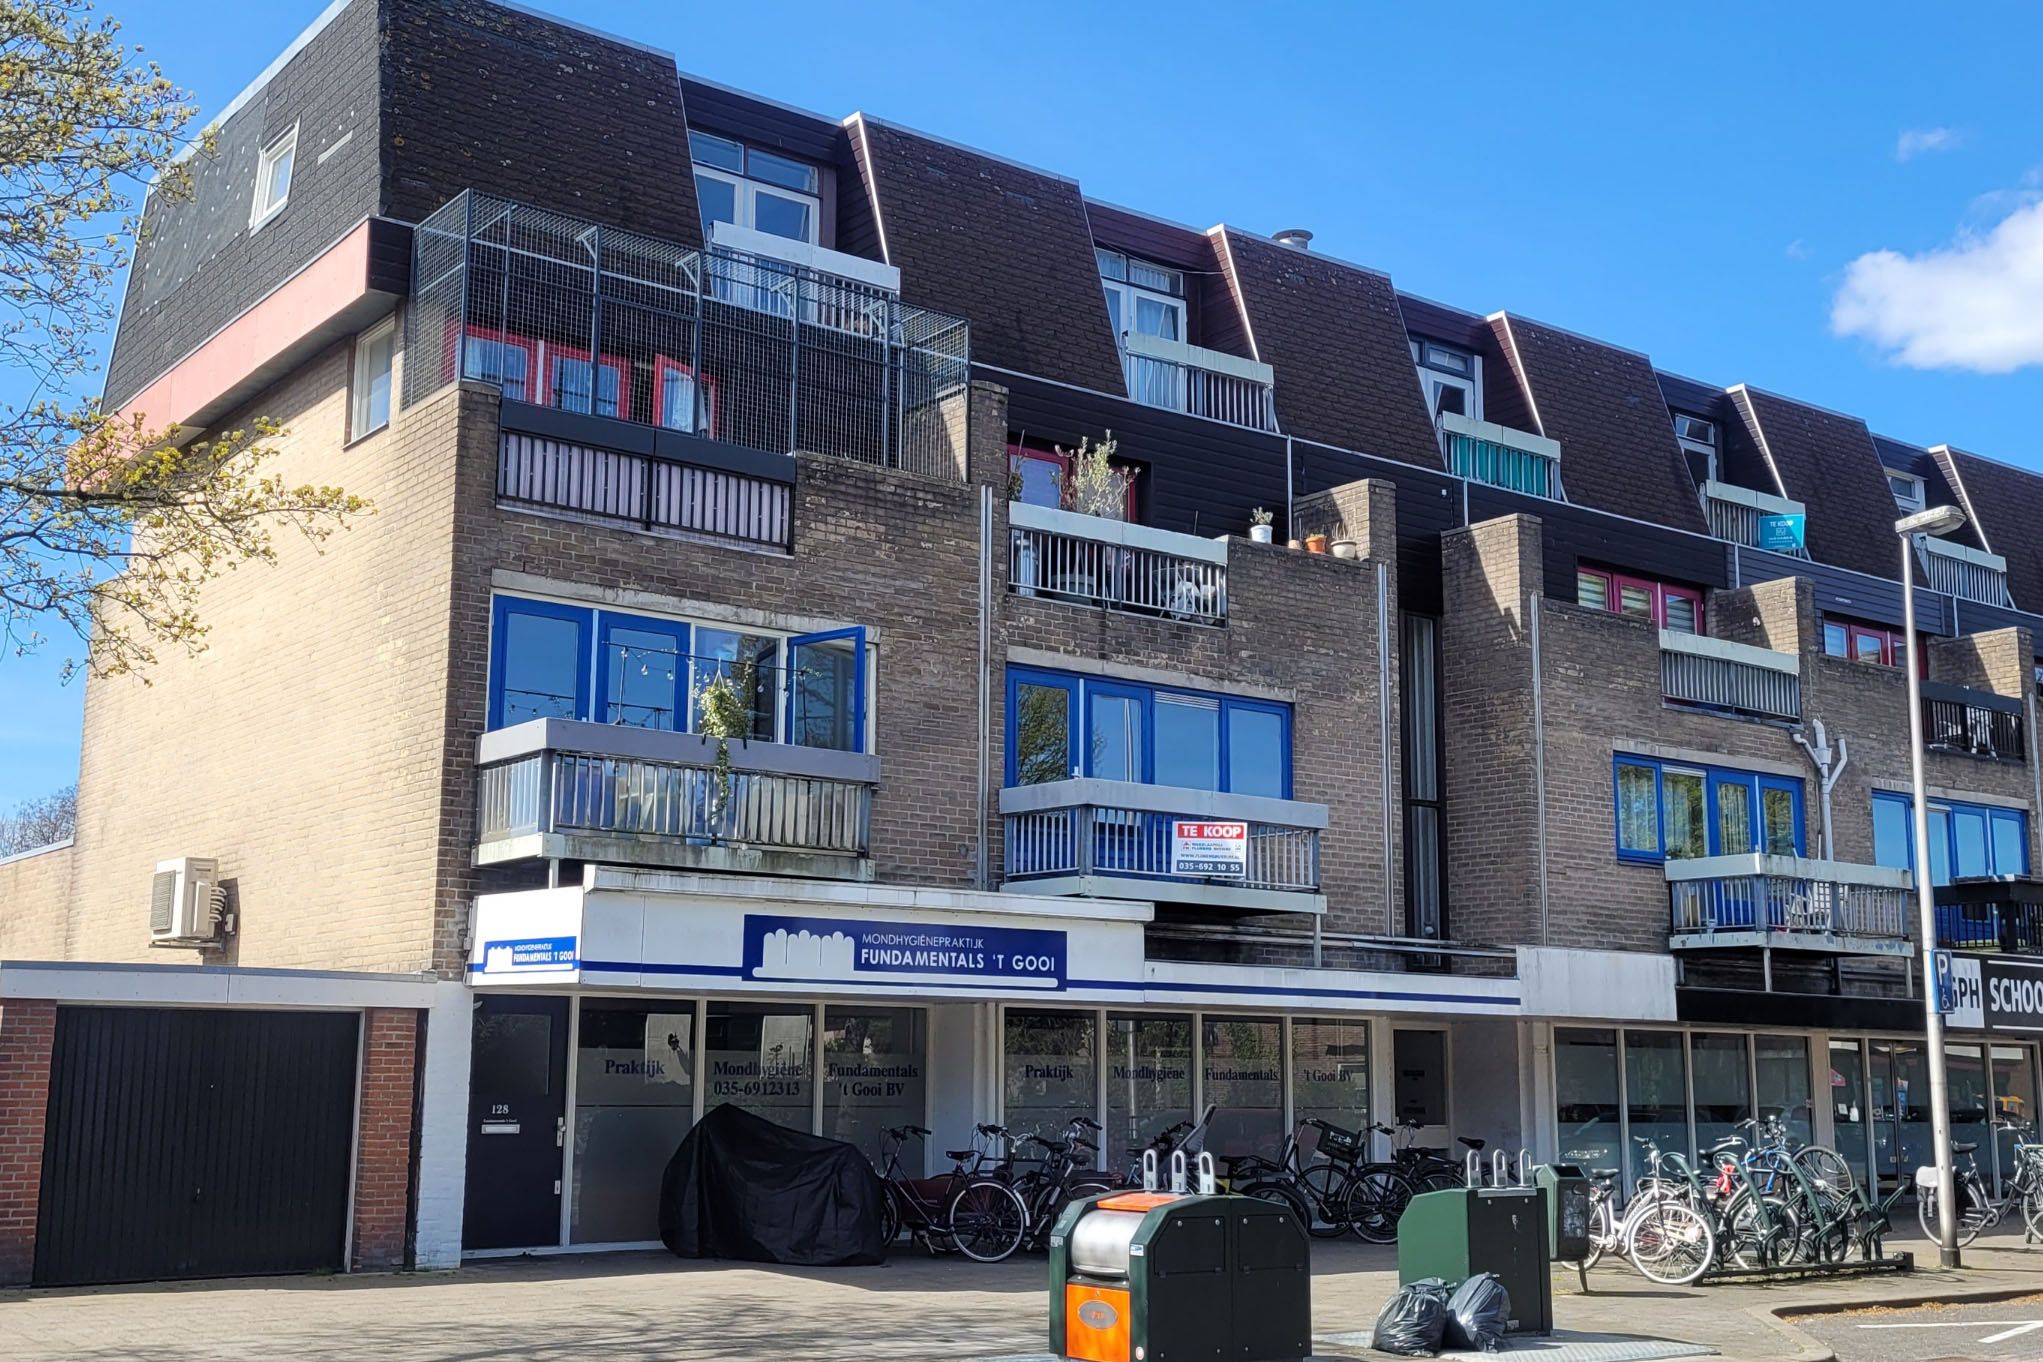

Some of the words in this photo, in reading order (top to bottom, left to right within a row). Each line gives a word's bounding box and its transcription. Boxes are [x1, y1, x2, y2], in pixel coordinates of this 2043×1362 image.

[1181, 825, 1198, 837] TE
[1203, 826, 1241, 838] KOOP
[1179, 862, 1213, 871] 035-692
[1217, 863, 1226, 871] 10
[1230, 864, 1240, 872] 55
[860, 948, 985, 969] FUNDAMENTALS
[1012, 955, 1055, 972] GOOI
[1936, 953, 1948, 986] P
[605, 1059, 665, 1078] Praktijk
[828, 1062, 919, 1078] Fundamentals
[1024, 1064, 1074, 1082] Praktijk
[1205, 1067, 1279, 1081] Fundamentals
[1312, 1069, 1336, 1082] Gooi
[713, 1080, 800, 1096] 035-6912313
[852, 1081, 882, 1097] Gooi
[886, 1082, 905, 1096] BV
[491, 1104, 510, 1114] 128
